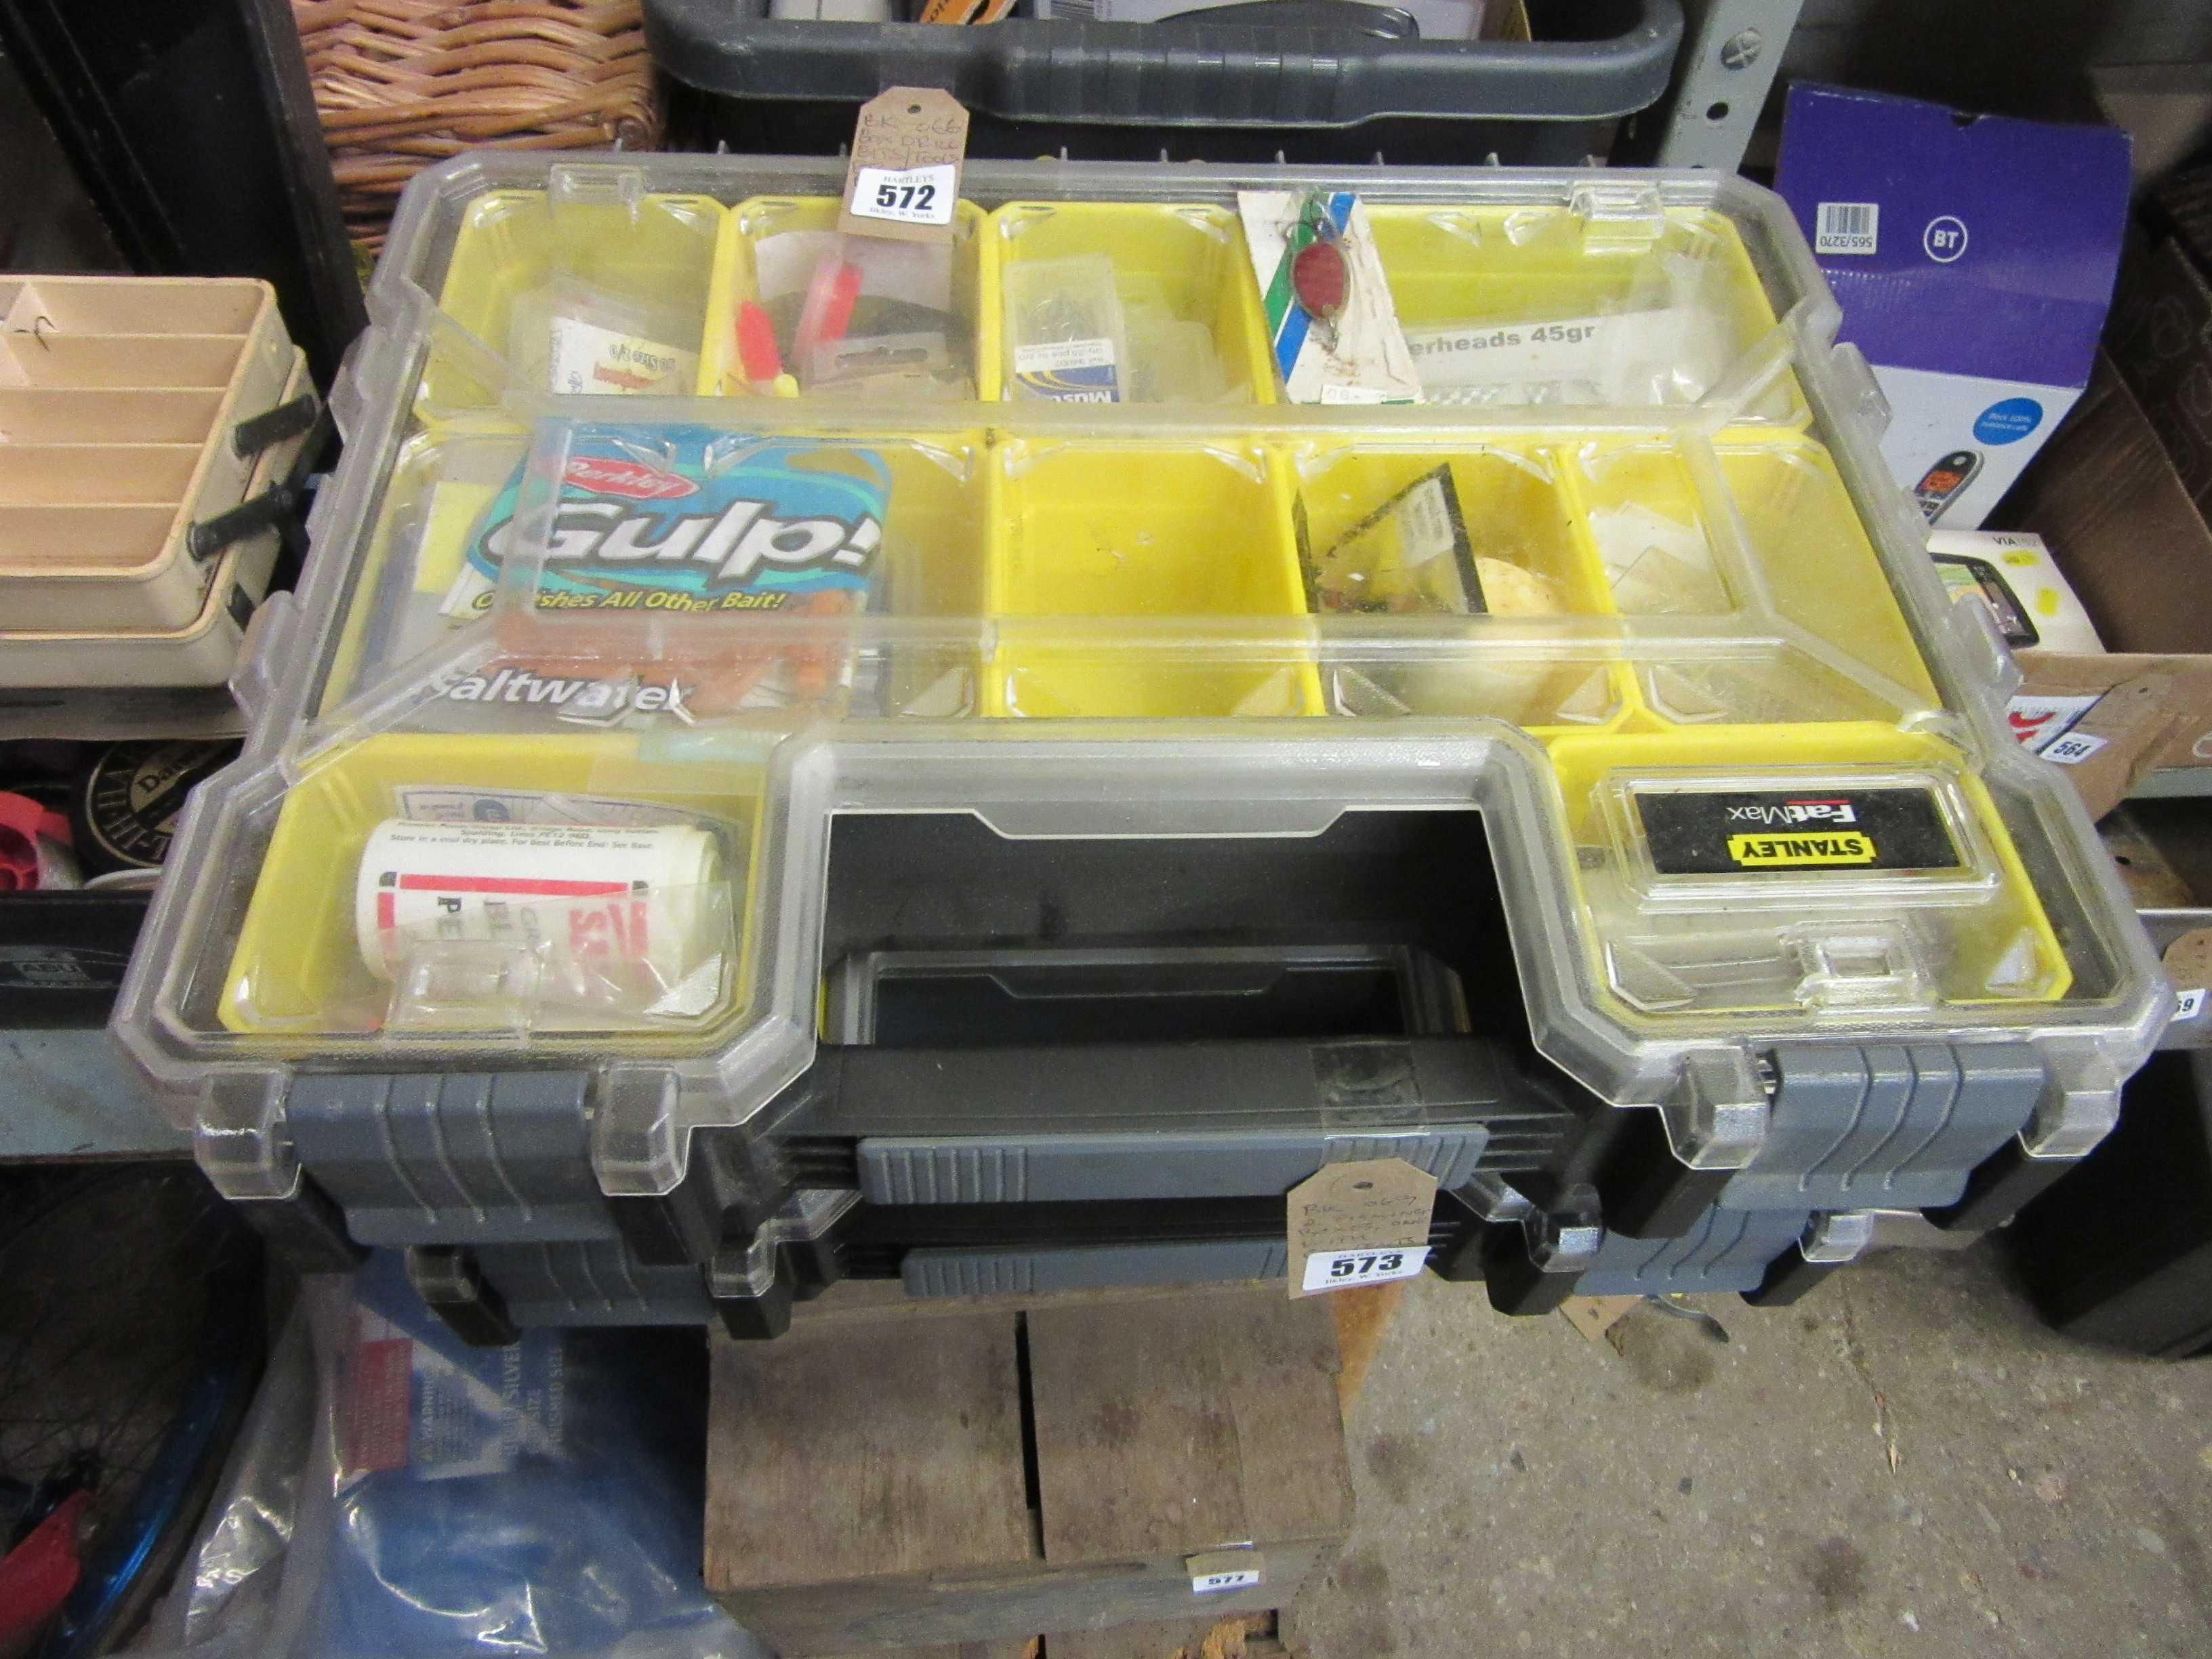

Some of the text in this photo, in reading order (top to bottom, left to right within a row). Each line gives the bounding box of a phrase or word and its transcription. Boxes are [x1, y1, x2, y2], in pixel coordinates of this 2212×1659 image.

[883, 174, 934, 184] HARTLEYS
[876, 184, 936, 211] 572
[912, 211, 935, 219] Yorks
[1820, 235, 1873, 248] 565/3270
[1933, 229, 1959, 249] BT
[1530, 325, 1595, 344] 45gr
[484, 500, 882, 579] Gulp!
[602, 592, 639, 609] All
[644, 592, 720, 611] Other
[726, 591, 787, 610] Bait!
[1727, 802, 1856, 825] FatMax
[390, 834, 415, 842] Store
[463, 837, 478, 846] dry
[554, 839, 585, 847] Before
[1742, 838, 1863, 859] STANLEY
[1330, 1254, 1404, 1278] 573
[1208, 1575, 1244, 1585] 577
